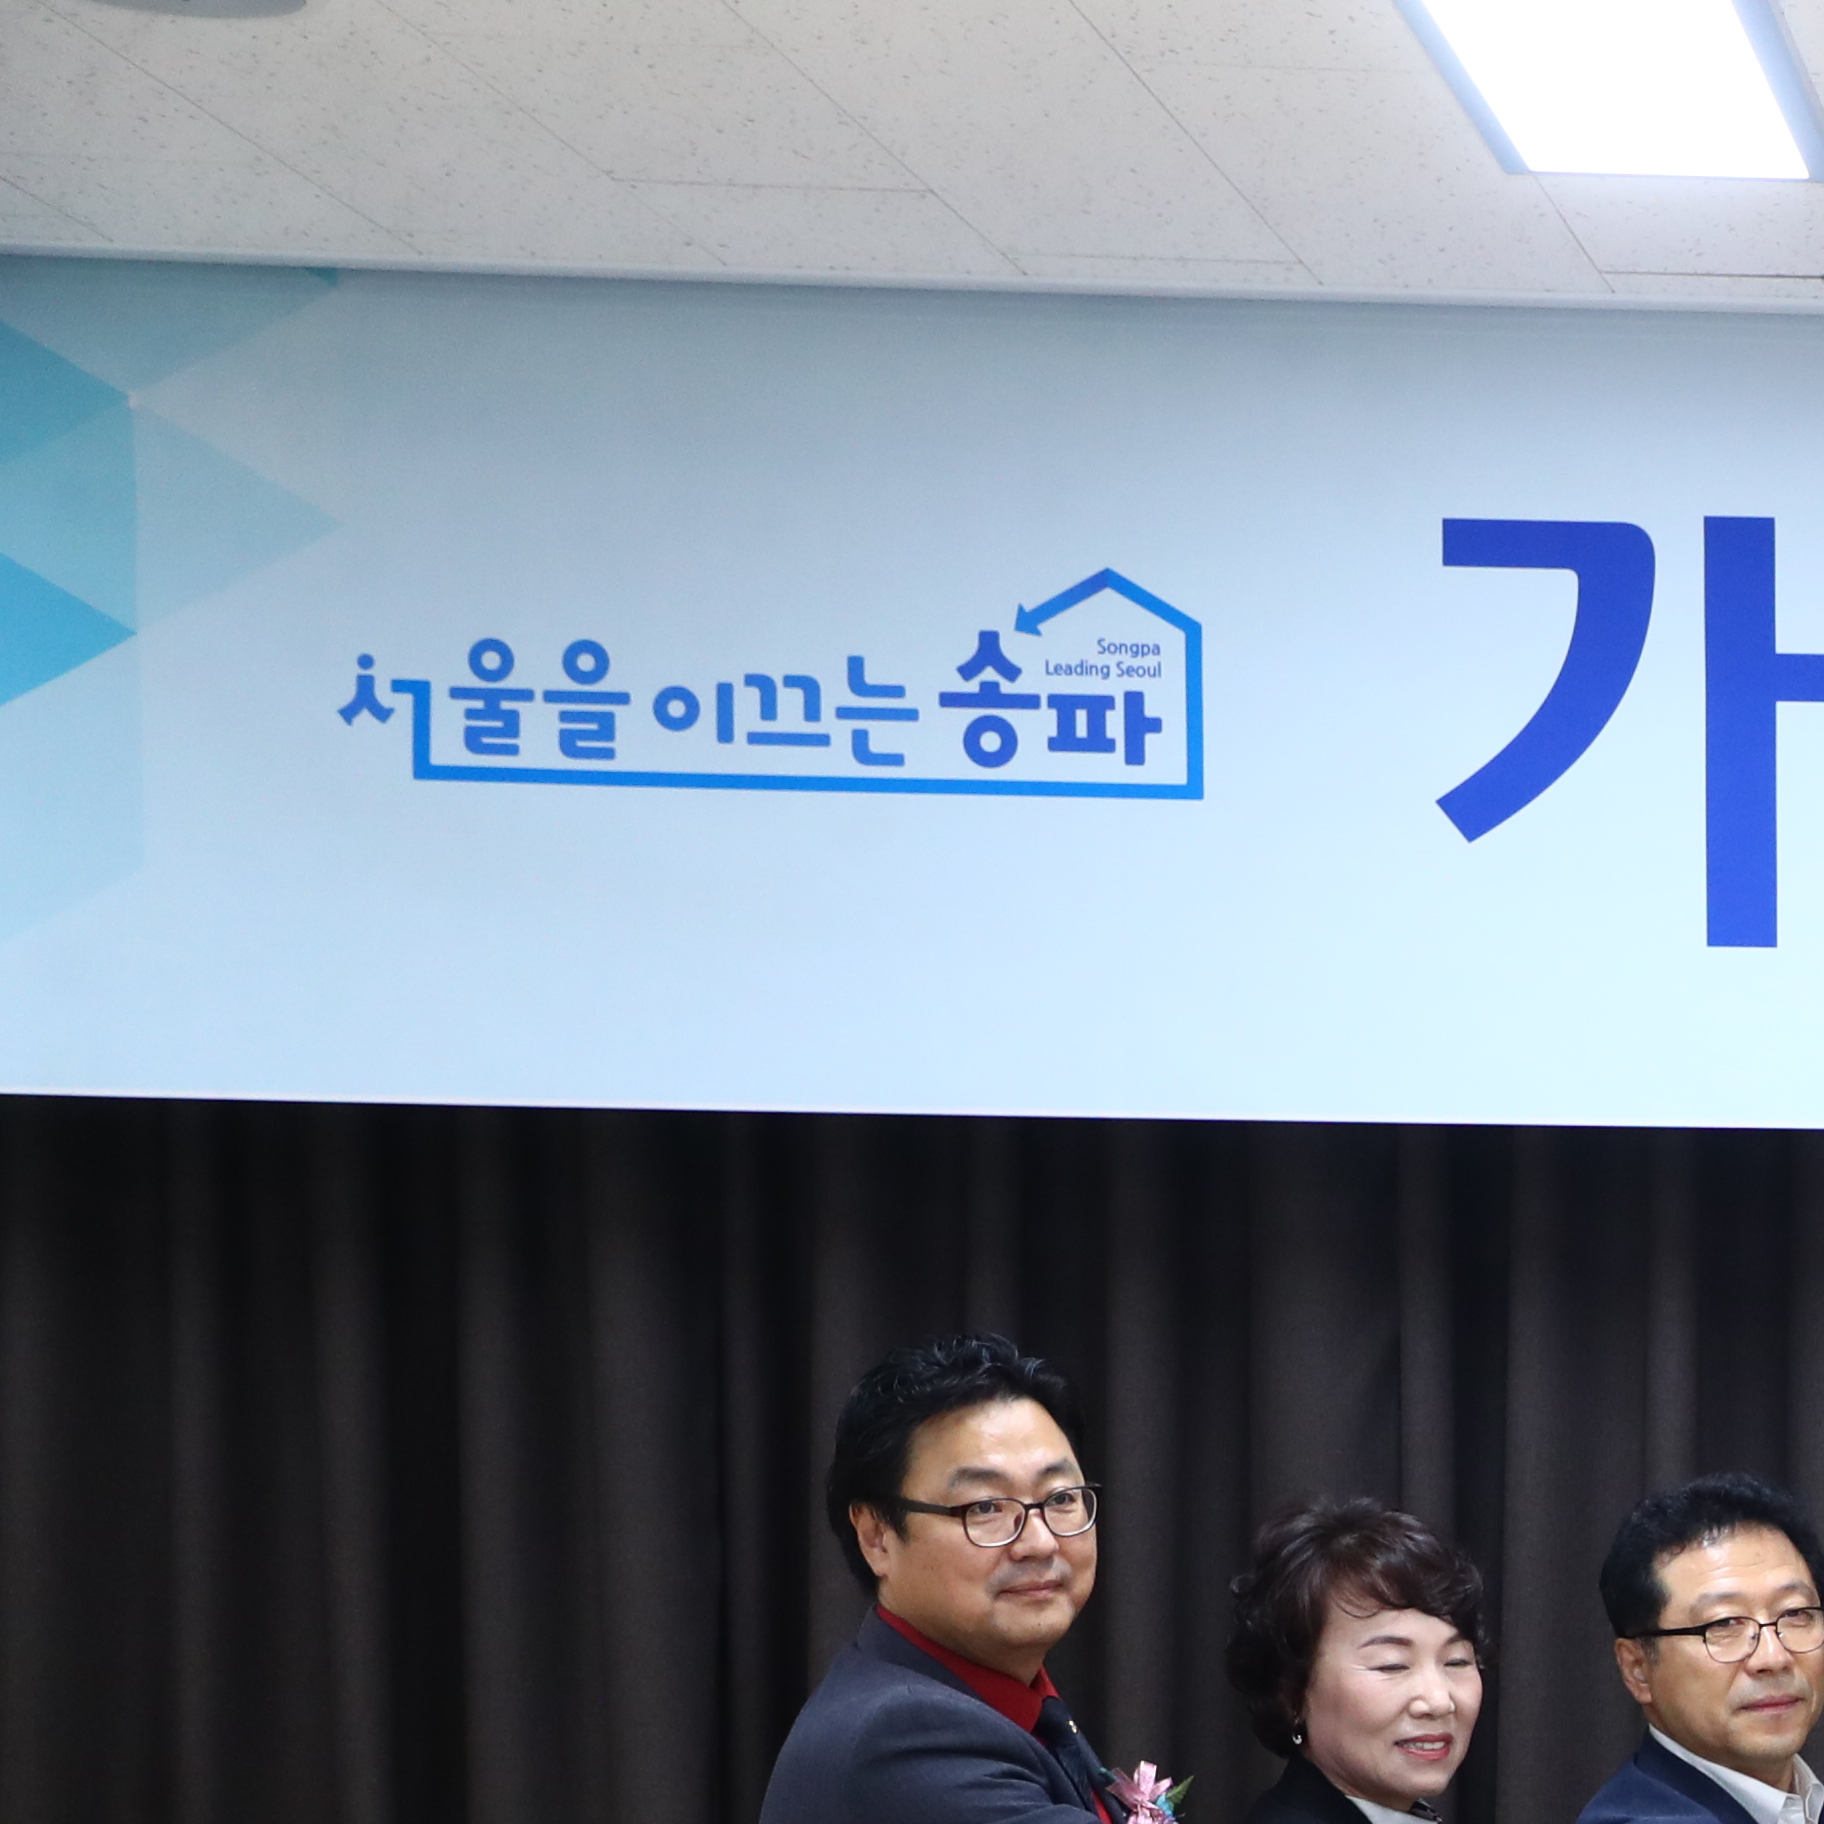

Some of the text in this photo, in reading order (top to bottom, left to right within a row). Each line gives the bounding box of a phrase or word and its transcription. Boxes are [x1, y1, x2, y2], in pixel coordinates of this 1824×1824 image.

[1097, 637, 1161, 658] Songpa
[1044, 659, 1162, 680] Leading Seoul
[653, 655, 919, 767] 이끄는
[939, 629, 1162, 768] 송파
